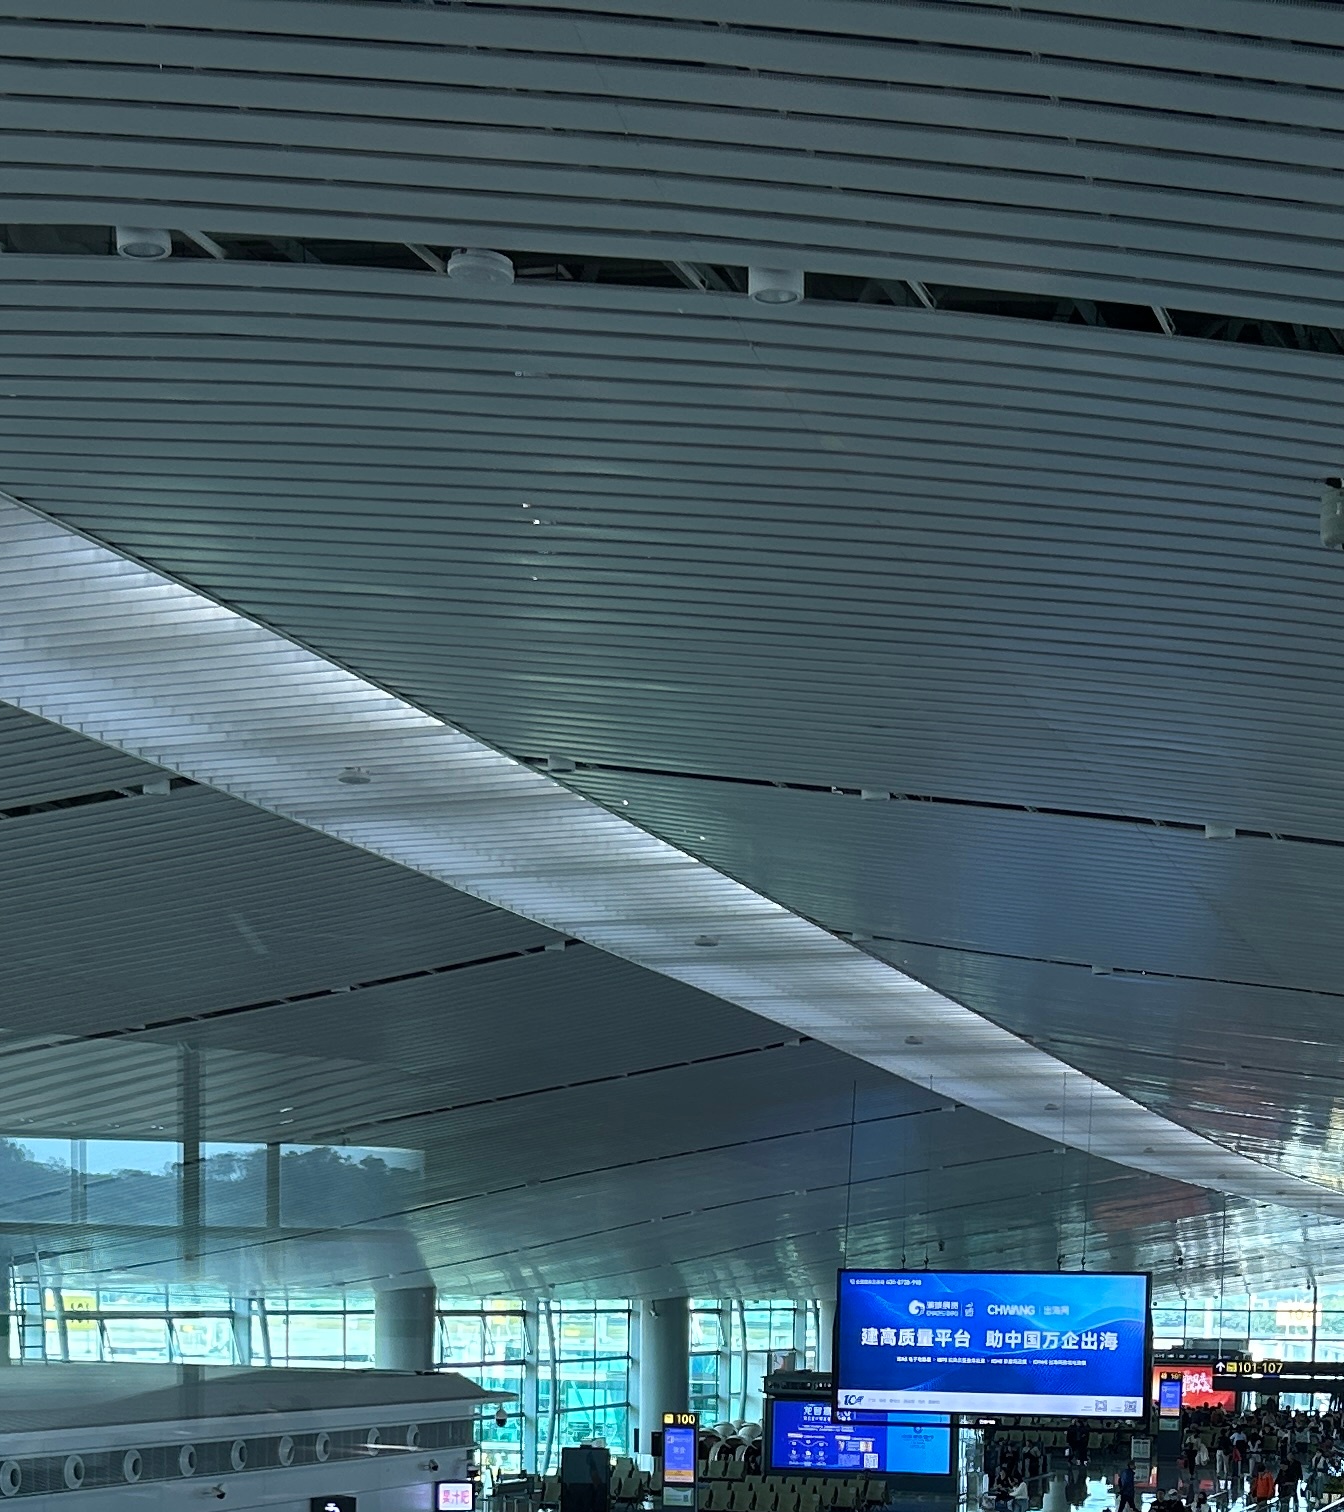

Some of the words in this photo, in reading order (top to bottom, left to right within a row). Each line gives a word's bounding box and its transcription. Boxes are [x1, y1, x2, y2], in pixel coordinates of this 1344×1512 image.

[861, 1327, 971, 1348] 建高质量平台
[985, 1329, 1119, 1351] 助中国万企出海
[1238, 1361, 1283, 1374] 101-107
[676, 1413, 695, 1424] 100
